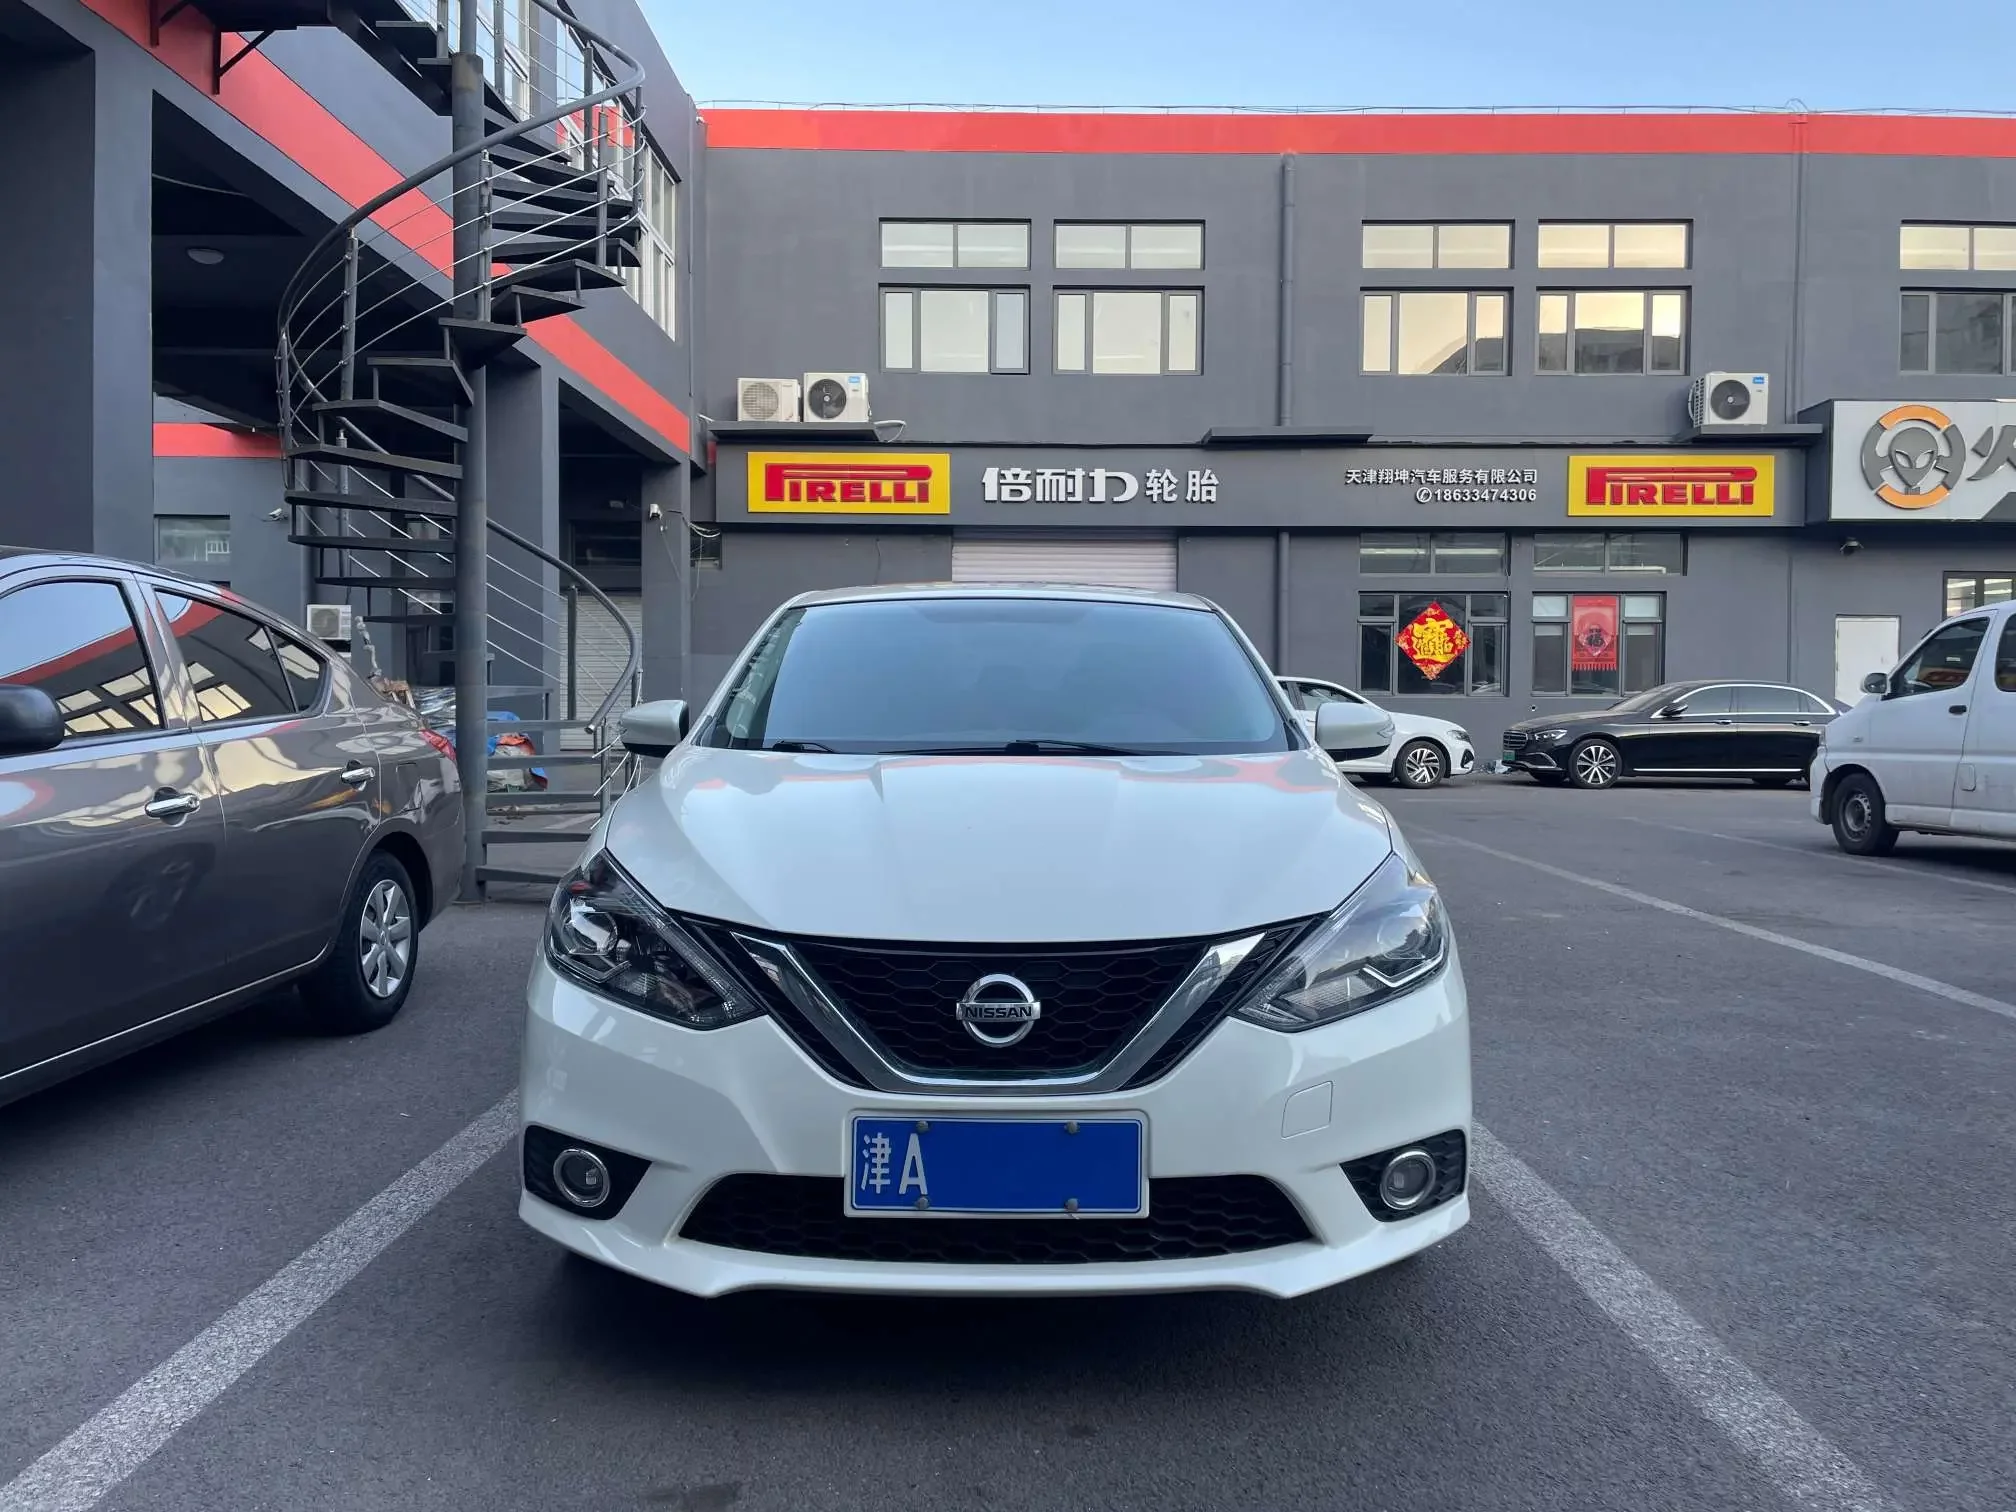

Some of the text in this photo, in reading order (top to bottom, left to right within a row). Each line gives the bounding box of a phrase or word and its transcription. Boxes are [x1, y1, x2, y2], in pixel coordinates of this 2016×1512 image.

[765, 463, 932, 503] PIRELLI
[1346, 468, 1537, 484] 天津翔坤汽车服务有限公司
[1586, 466, 1757, 505] PIRELLI
[1434, 488, 1537, 501] 18633474306
[964, 1006, 1032, 1018] NISSAN
